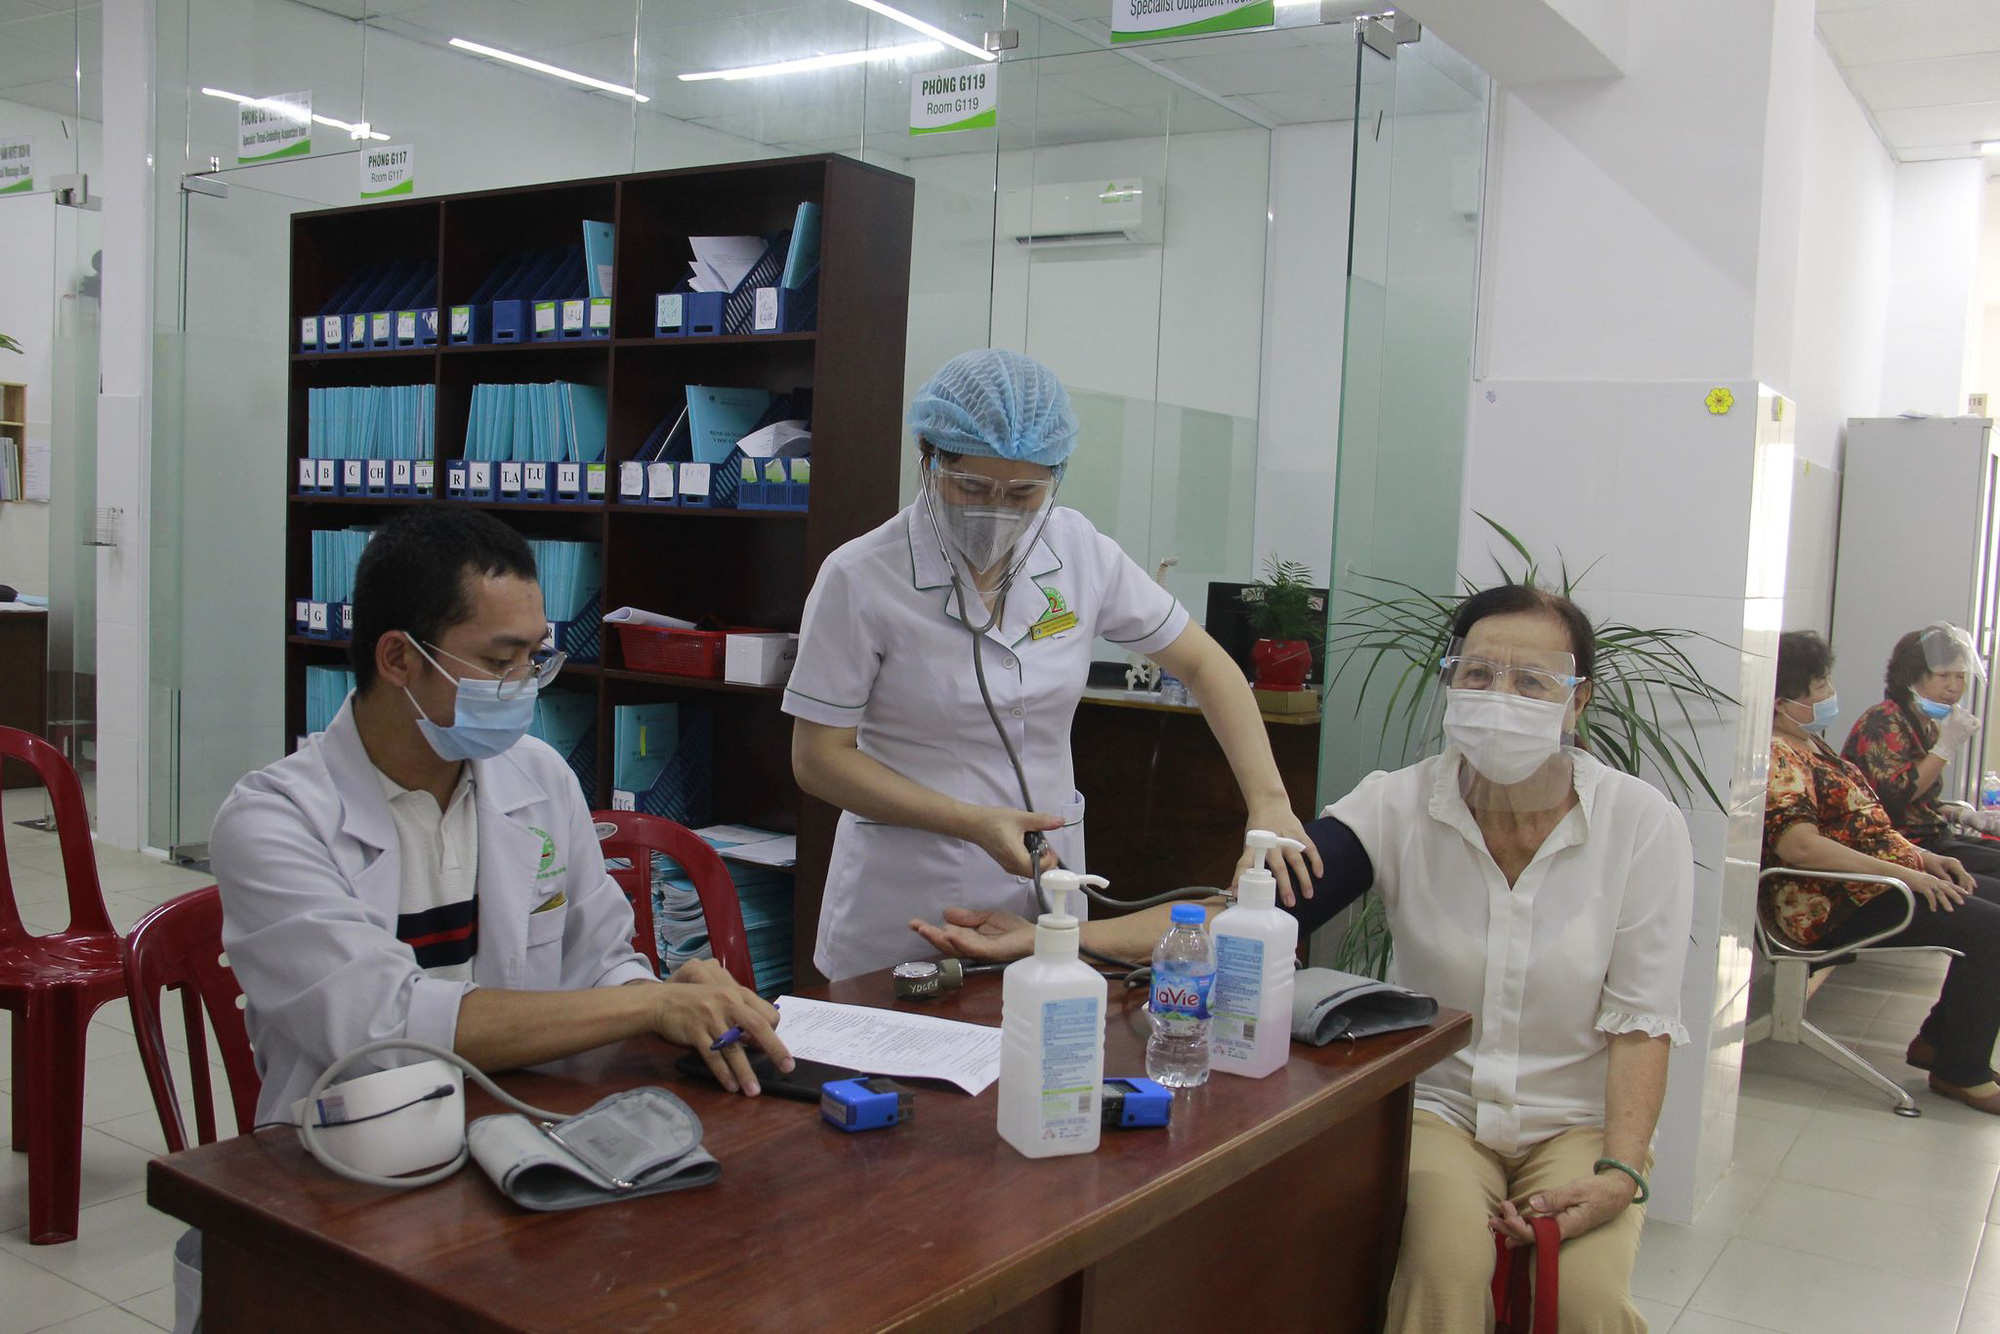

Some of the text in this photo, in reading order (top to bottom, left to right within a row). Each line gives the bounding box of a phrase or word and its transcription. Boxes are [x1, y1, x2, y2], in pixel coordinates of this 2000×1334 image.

[1130, 0, 1174, 20] Specialist
[922, 73, 986, 96] PHÒNG G119
[926, 97, 979, 115] Room G119
[368, 151, 407, 168] PHÒNG G117
[371, 170, 403, 183] Room G117
[304, 468, 311, 479] A
[323, 467, 330, 479] B
[349, 465, 356, 477] C
[369, 467, 384, 479] CH
[398, 464, 405, 476] D
[527, 468, 544, 480] T.U
[453, 473, 461, 485] R
[476, 471, 483, 484] S
[503, 471, 519, 483] T.A
[562, 472, 575, 482] T.I
[314, 610, 321, 621] G
[344, 609, 350, 620] H
